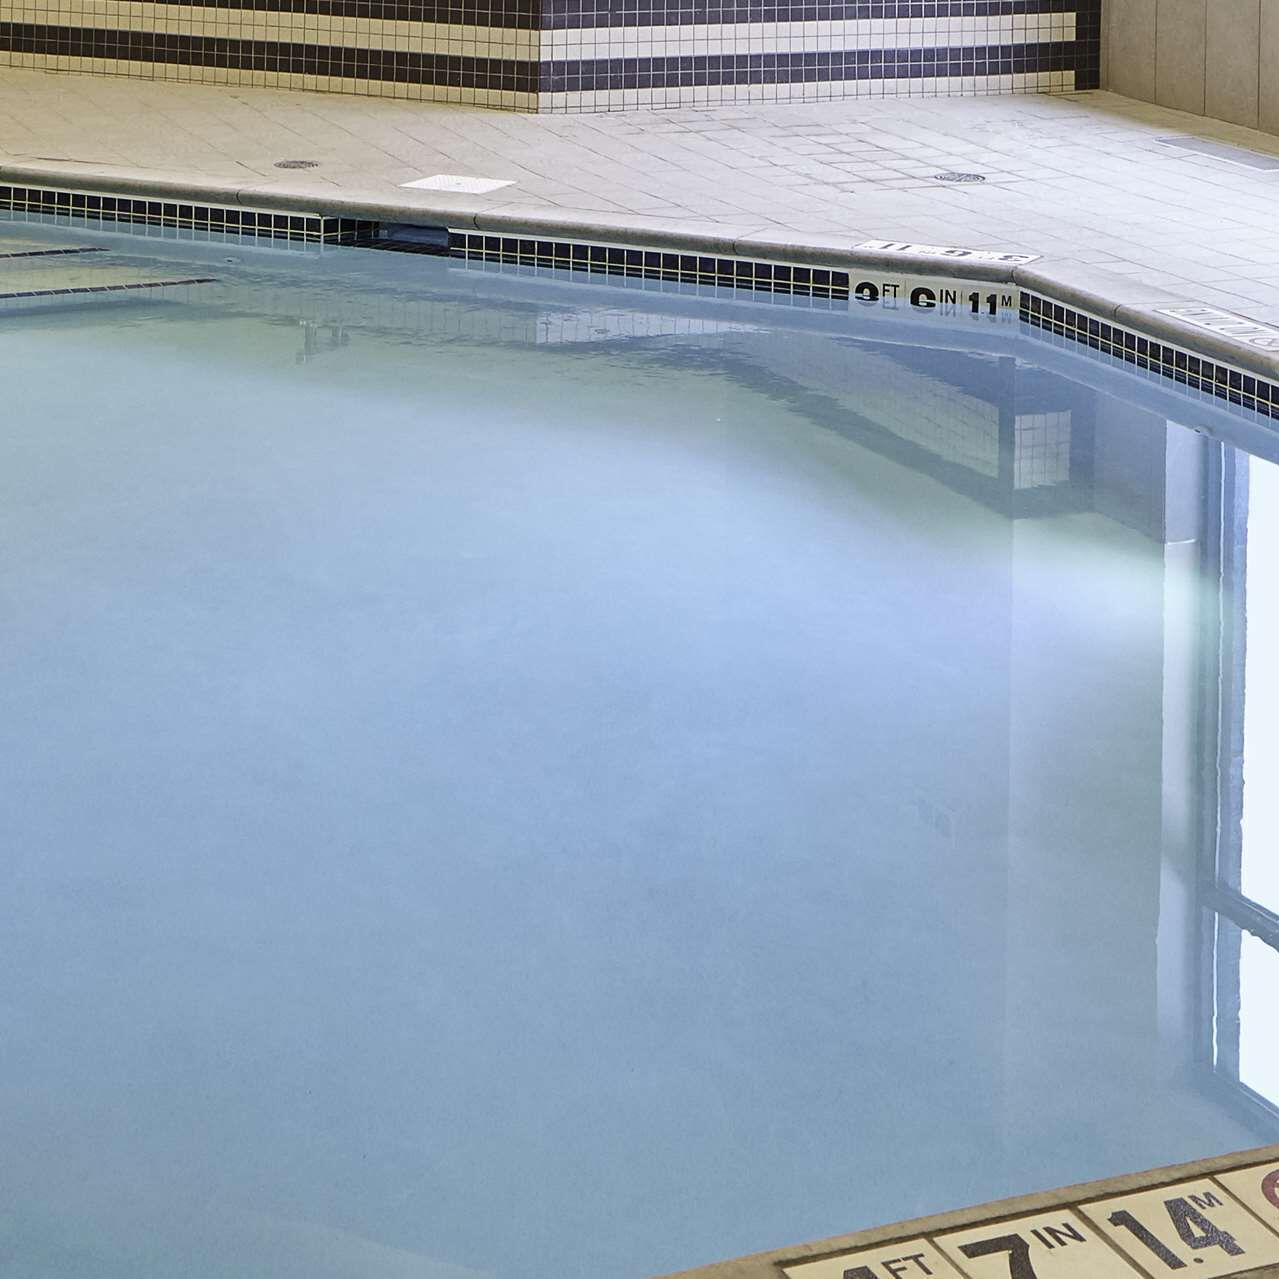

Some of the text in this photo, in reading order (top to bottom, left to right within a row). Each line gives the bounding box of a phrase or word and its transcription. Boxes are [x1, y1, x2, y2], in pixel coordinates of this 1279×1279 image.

[883, 284, 900, 298] FT
[940, 289, 957, 305] IN
[1001, 295, 1012, 307] M
[881, 1253, 933, 1279] FT
[958, 1233, 1038, 1279] 7
[1030, 1222, 1087, 1249] IN
[1187, 1191, 1224, 1210] M
